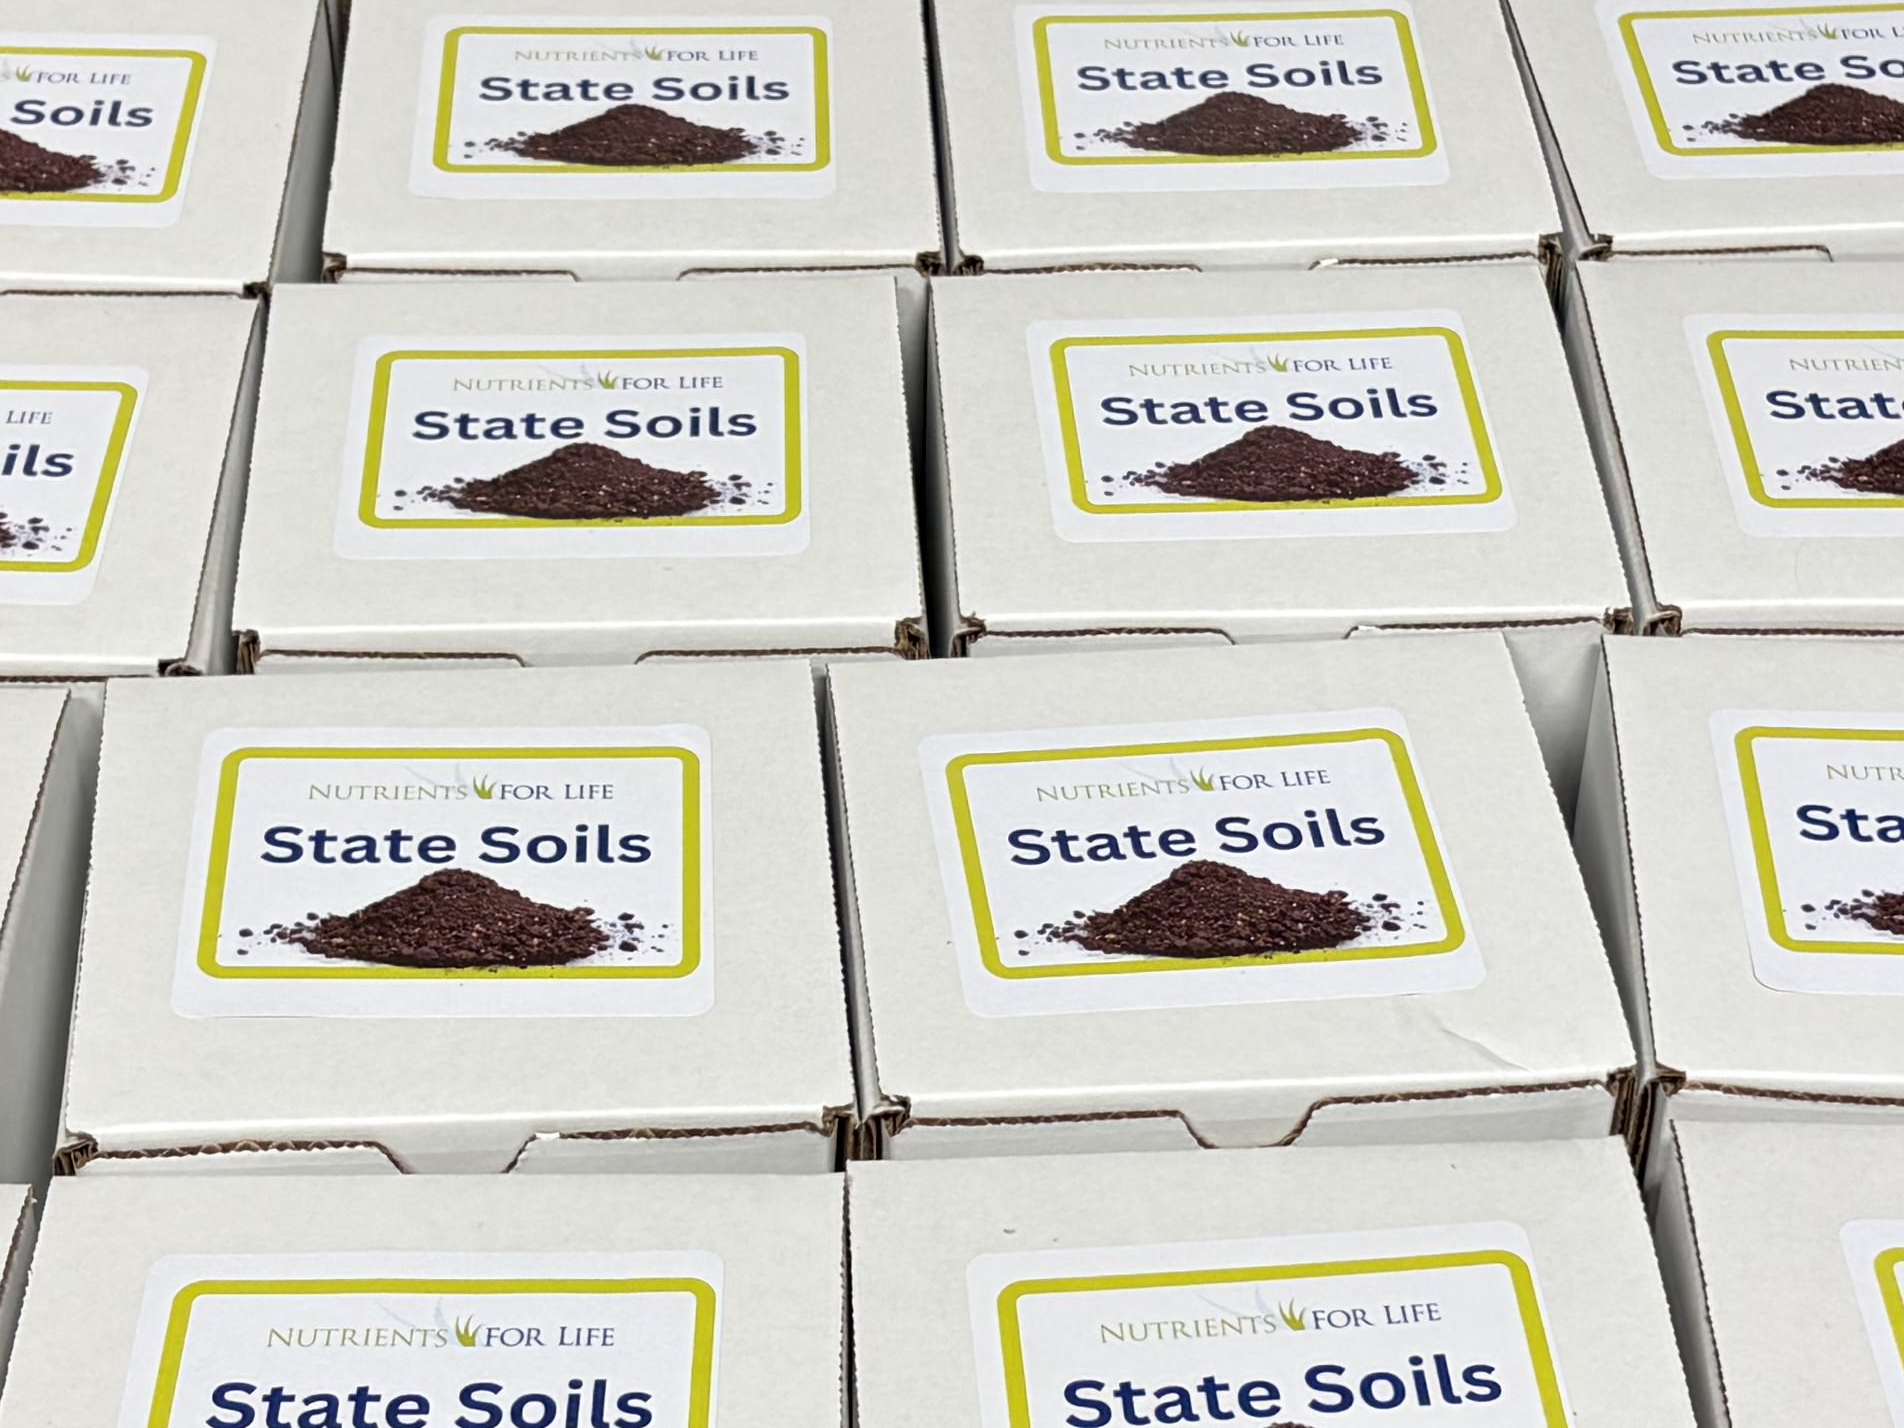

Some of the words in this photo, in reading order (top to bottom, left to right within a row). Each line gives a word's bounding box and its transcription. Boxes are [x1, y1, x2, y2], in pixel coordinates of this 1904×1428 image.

[1078, 66, 1232, 92] State
[1248, 60, 1384, 88] Soils
[1672, 59, 1827, 84] State
[479, 76, 634, 101] State
[652, 75, 789, 101] Soils
[9, 99, 153, 126] Soils
[1131, 361, 1268, 377] NUTRIENTS
[1293, 358, 1342, 372] FOR
[1349, 357, 1394, 370] LIFE
[453, 378, 593, 391] NUTRIENTS
[621, 377, 669, 390] FOR
[678, 376, 723, 389] LIFE
[5, 409, 53, 424] LIFE
[1101, 396, 1270, 426] State
[1288, 387, 1438, 421] Soils
[411, 411, 584, 441] State
[603, 407, 756, 439] Soils
[309, 784, 467, 800] NUTRIENTS
[499, 784, 552, 800] FOR
[563, 783, 613, 800] LIFE
[1036, 778, 1190, 801] NUTRIENTS
[1217, 772, 1273, 790] FOR
[1279, 768, 1331, 785] LIFE
[260, 826, 456, 864] State
[478, 823, 650, 864] Soils
[1007, 824, 1196, 865] State
[1214, 807, 1385, 853] Soils
[267, 1327, 448, 1347] NUTRIENTS
[484, 1326, 545, 1347] FOR
[557, 1325, 614, 1346] LIFE
[1102, 1314, 1280, 1344] NUTRIENTS
[1313, 1307, 1376, 1330] FOR
[1385, 1302, 1444, 1324] LIFE
[1064, 1375, 1284, 1428] State
[1307, 1354, 1503, 1414] Soils
